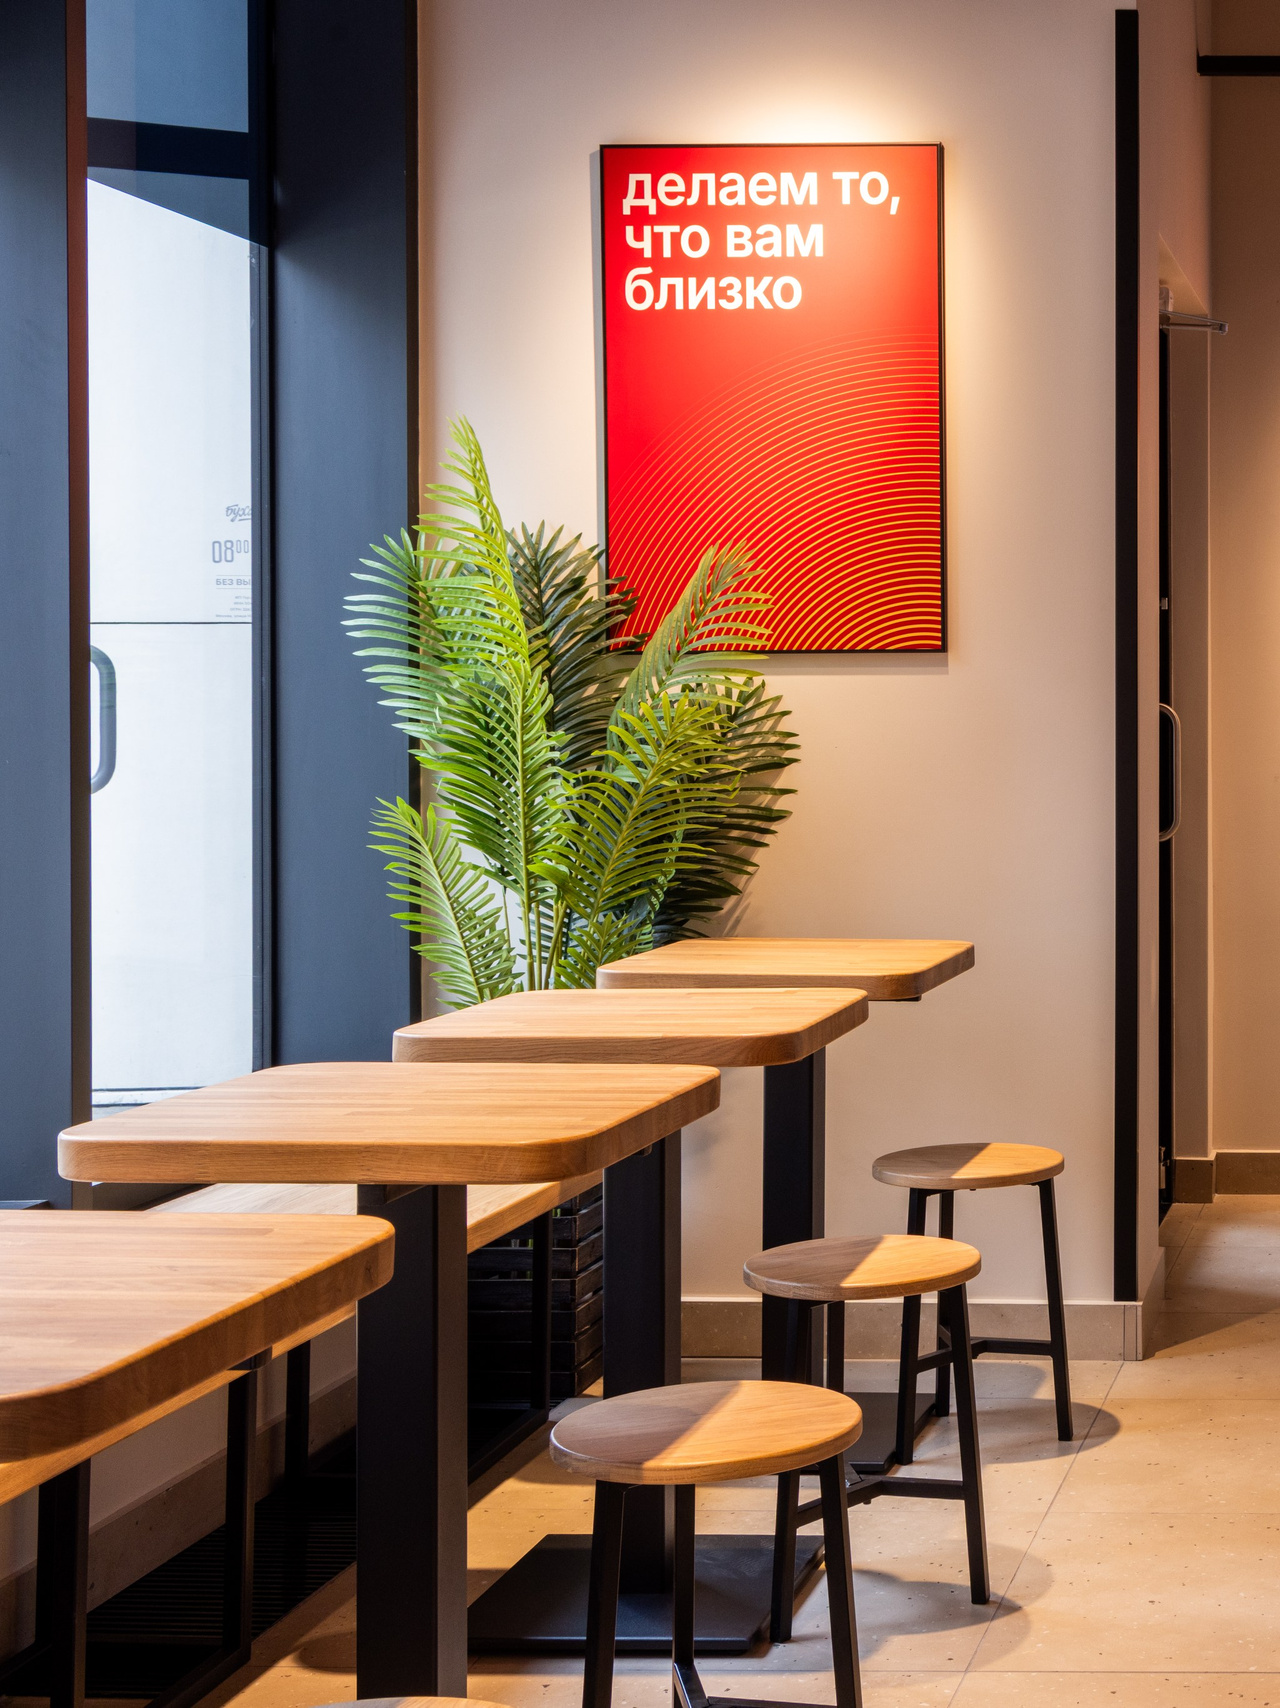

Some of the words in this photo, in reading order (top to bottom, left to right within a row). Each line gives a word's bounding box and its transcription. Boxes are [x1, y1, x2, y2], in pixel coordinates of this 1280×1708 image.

[622, 171, 818, 215] делаем
[832, 170, 900, 215] то,
[625, 224, 710, 258] что
[726, 223, 824, 258] вам
[624, 266, 803, 311] близко
